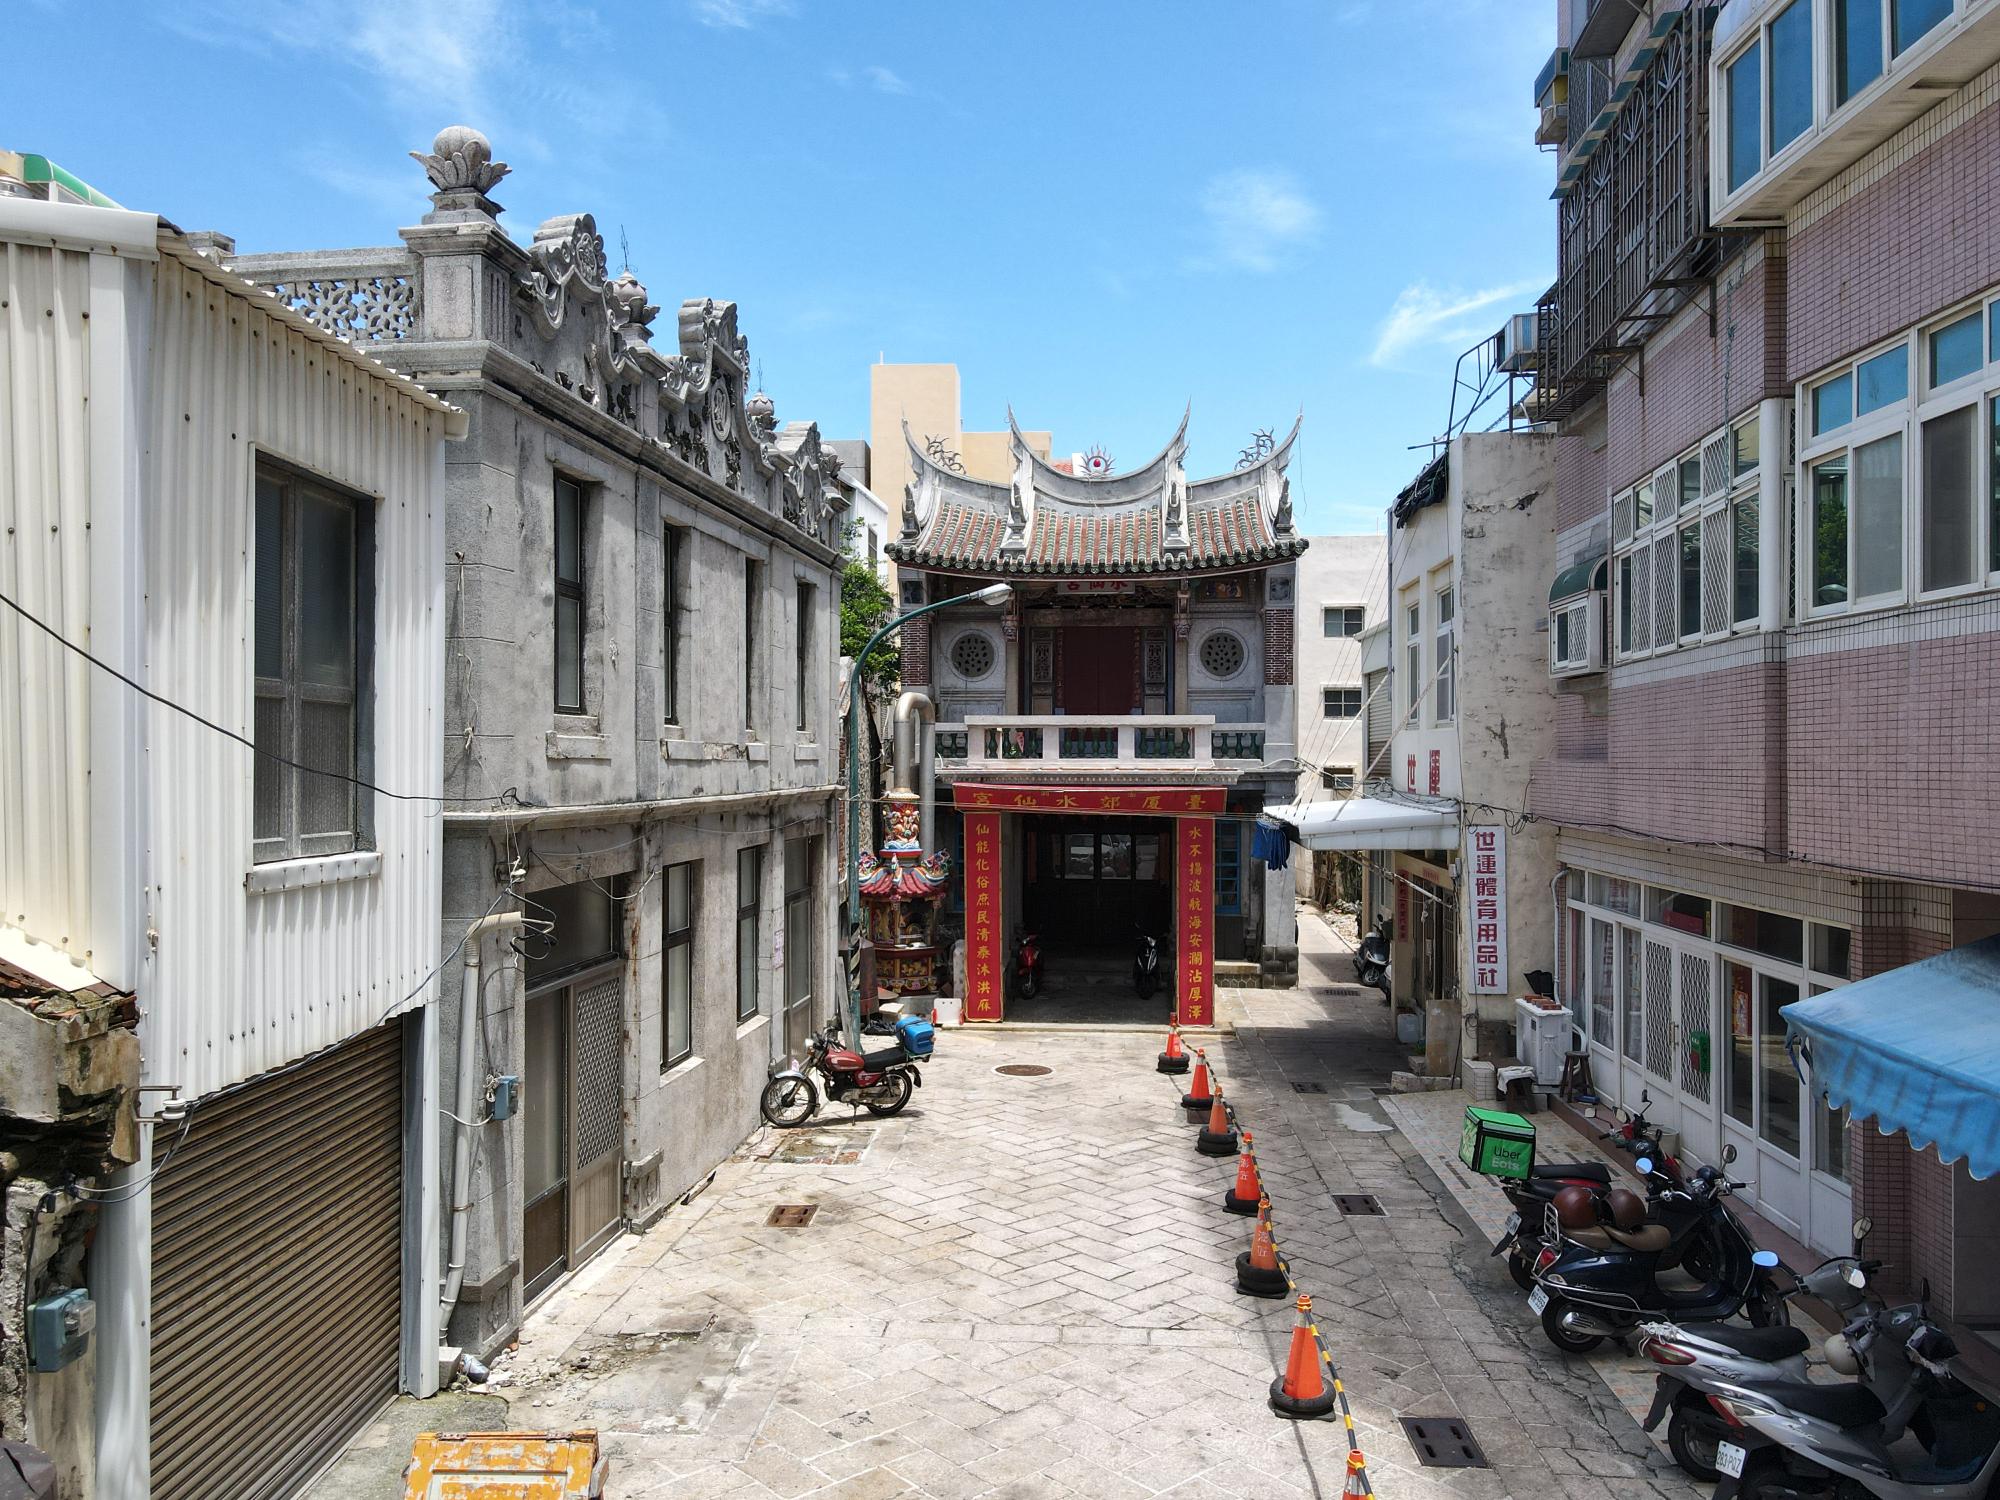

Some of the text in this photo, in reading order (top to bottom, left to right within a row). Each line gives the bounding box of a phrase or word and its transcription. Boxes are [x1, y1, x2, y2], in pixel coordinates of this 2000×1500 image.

[1475, 831, 1499, 988] 世運體育用品社
[1494, 1145, 1521, 1159] Uber
[1491, 1157, 1520, 1171] Eats
